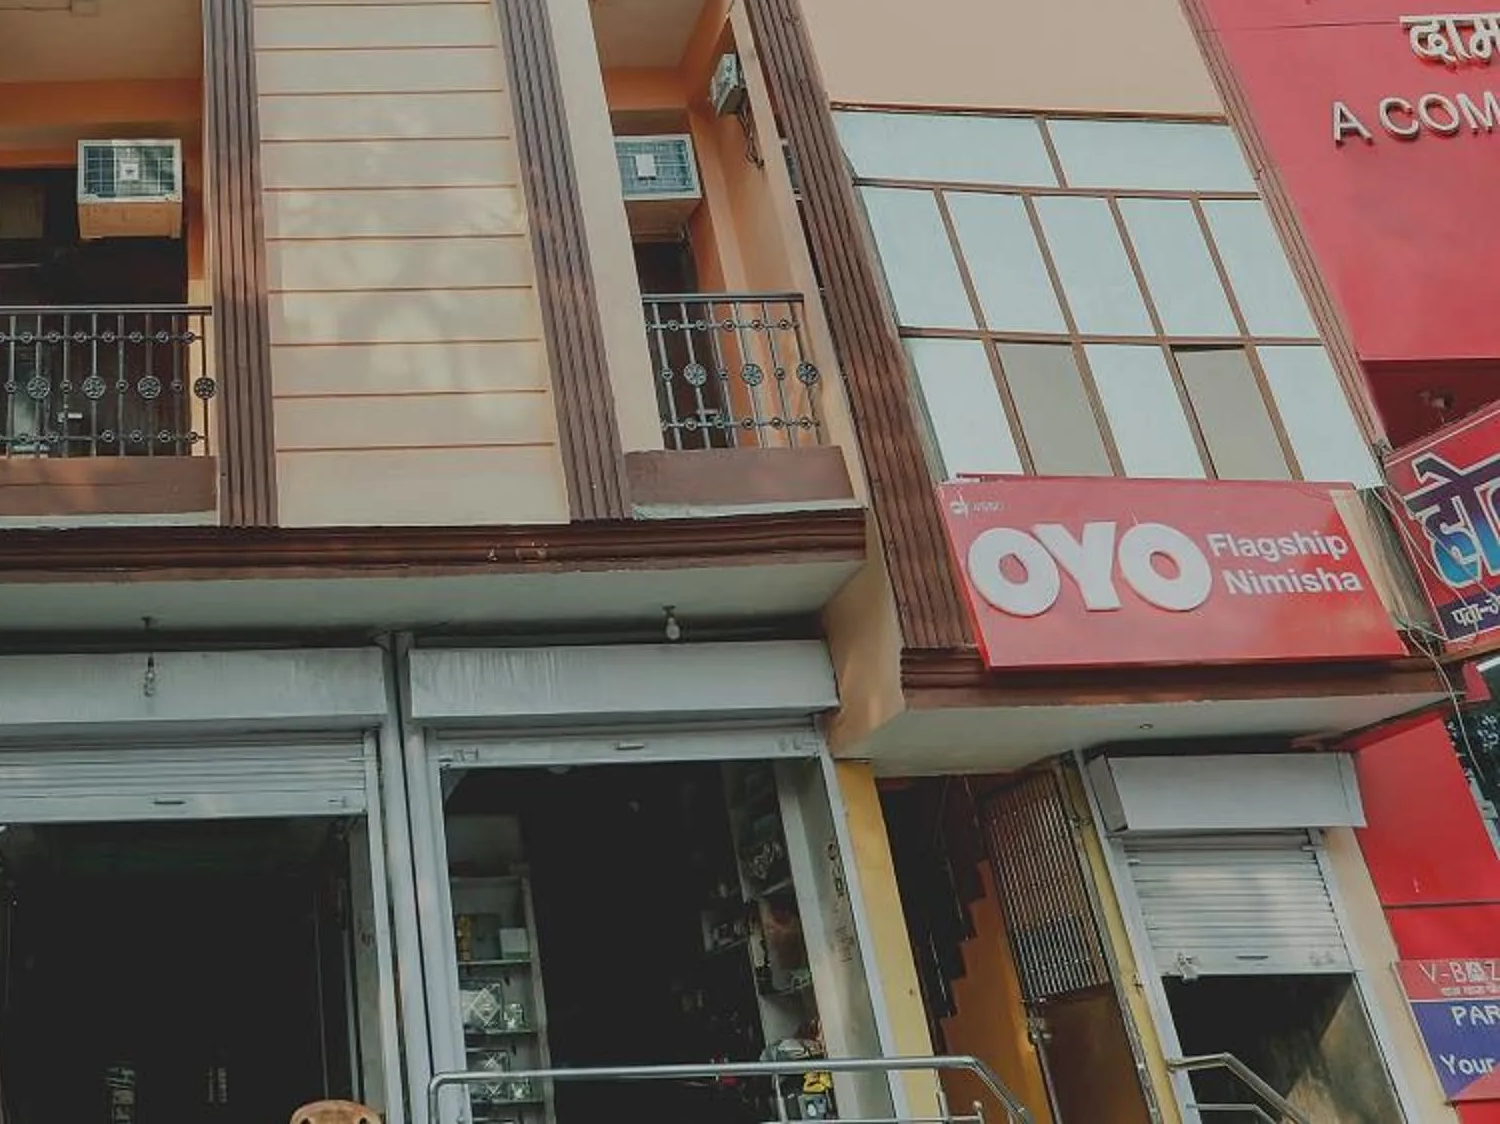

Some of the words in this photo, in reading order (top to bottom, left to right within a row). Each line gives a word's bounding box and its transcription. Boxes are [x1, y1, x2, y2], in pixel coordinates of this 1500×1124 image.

[1332, 101, 1372, 144] A
[1205, 530, 1350, 565] Flagship
[967, 521, 1213, 618] OYO
[1223, 566, 1363, 595] Nimisha
[1439, 1054, 1497, 1075] Your
